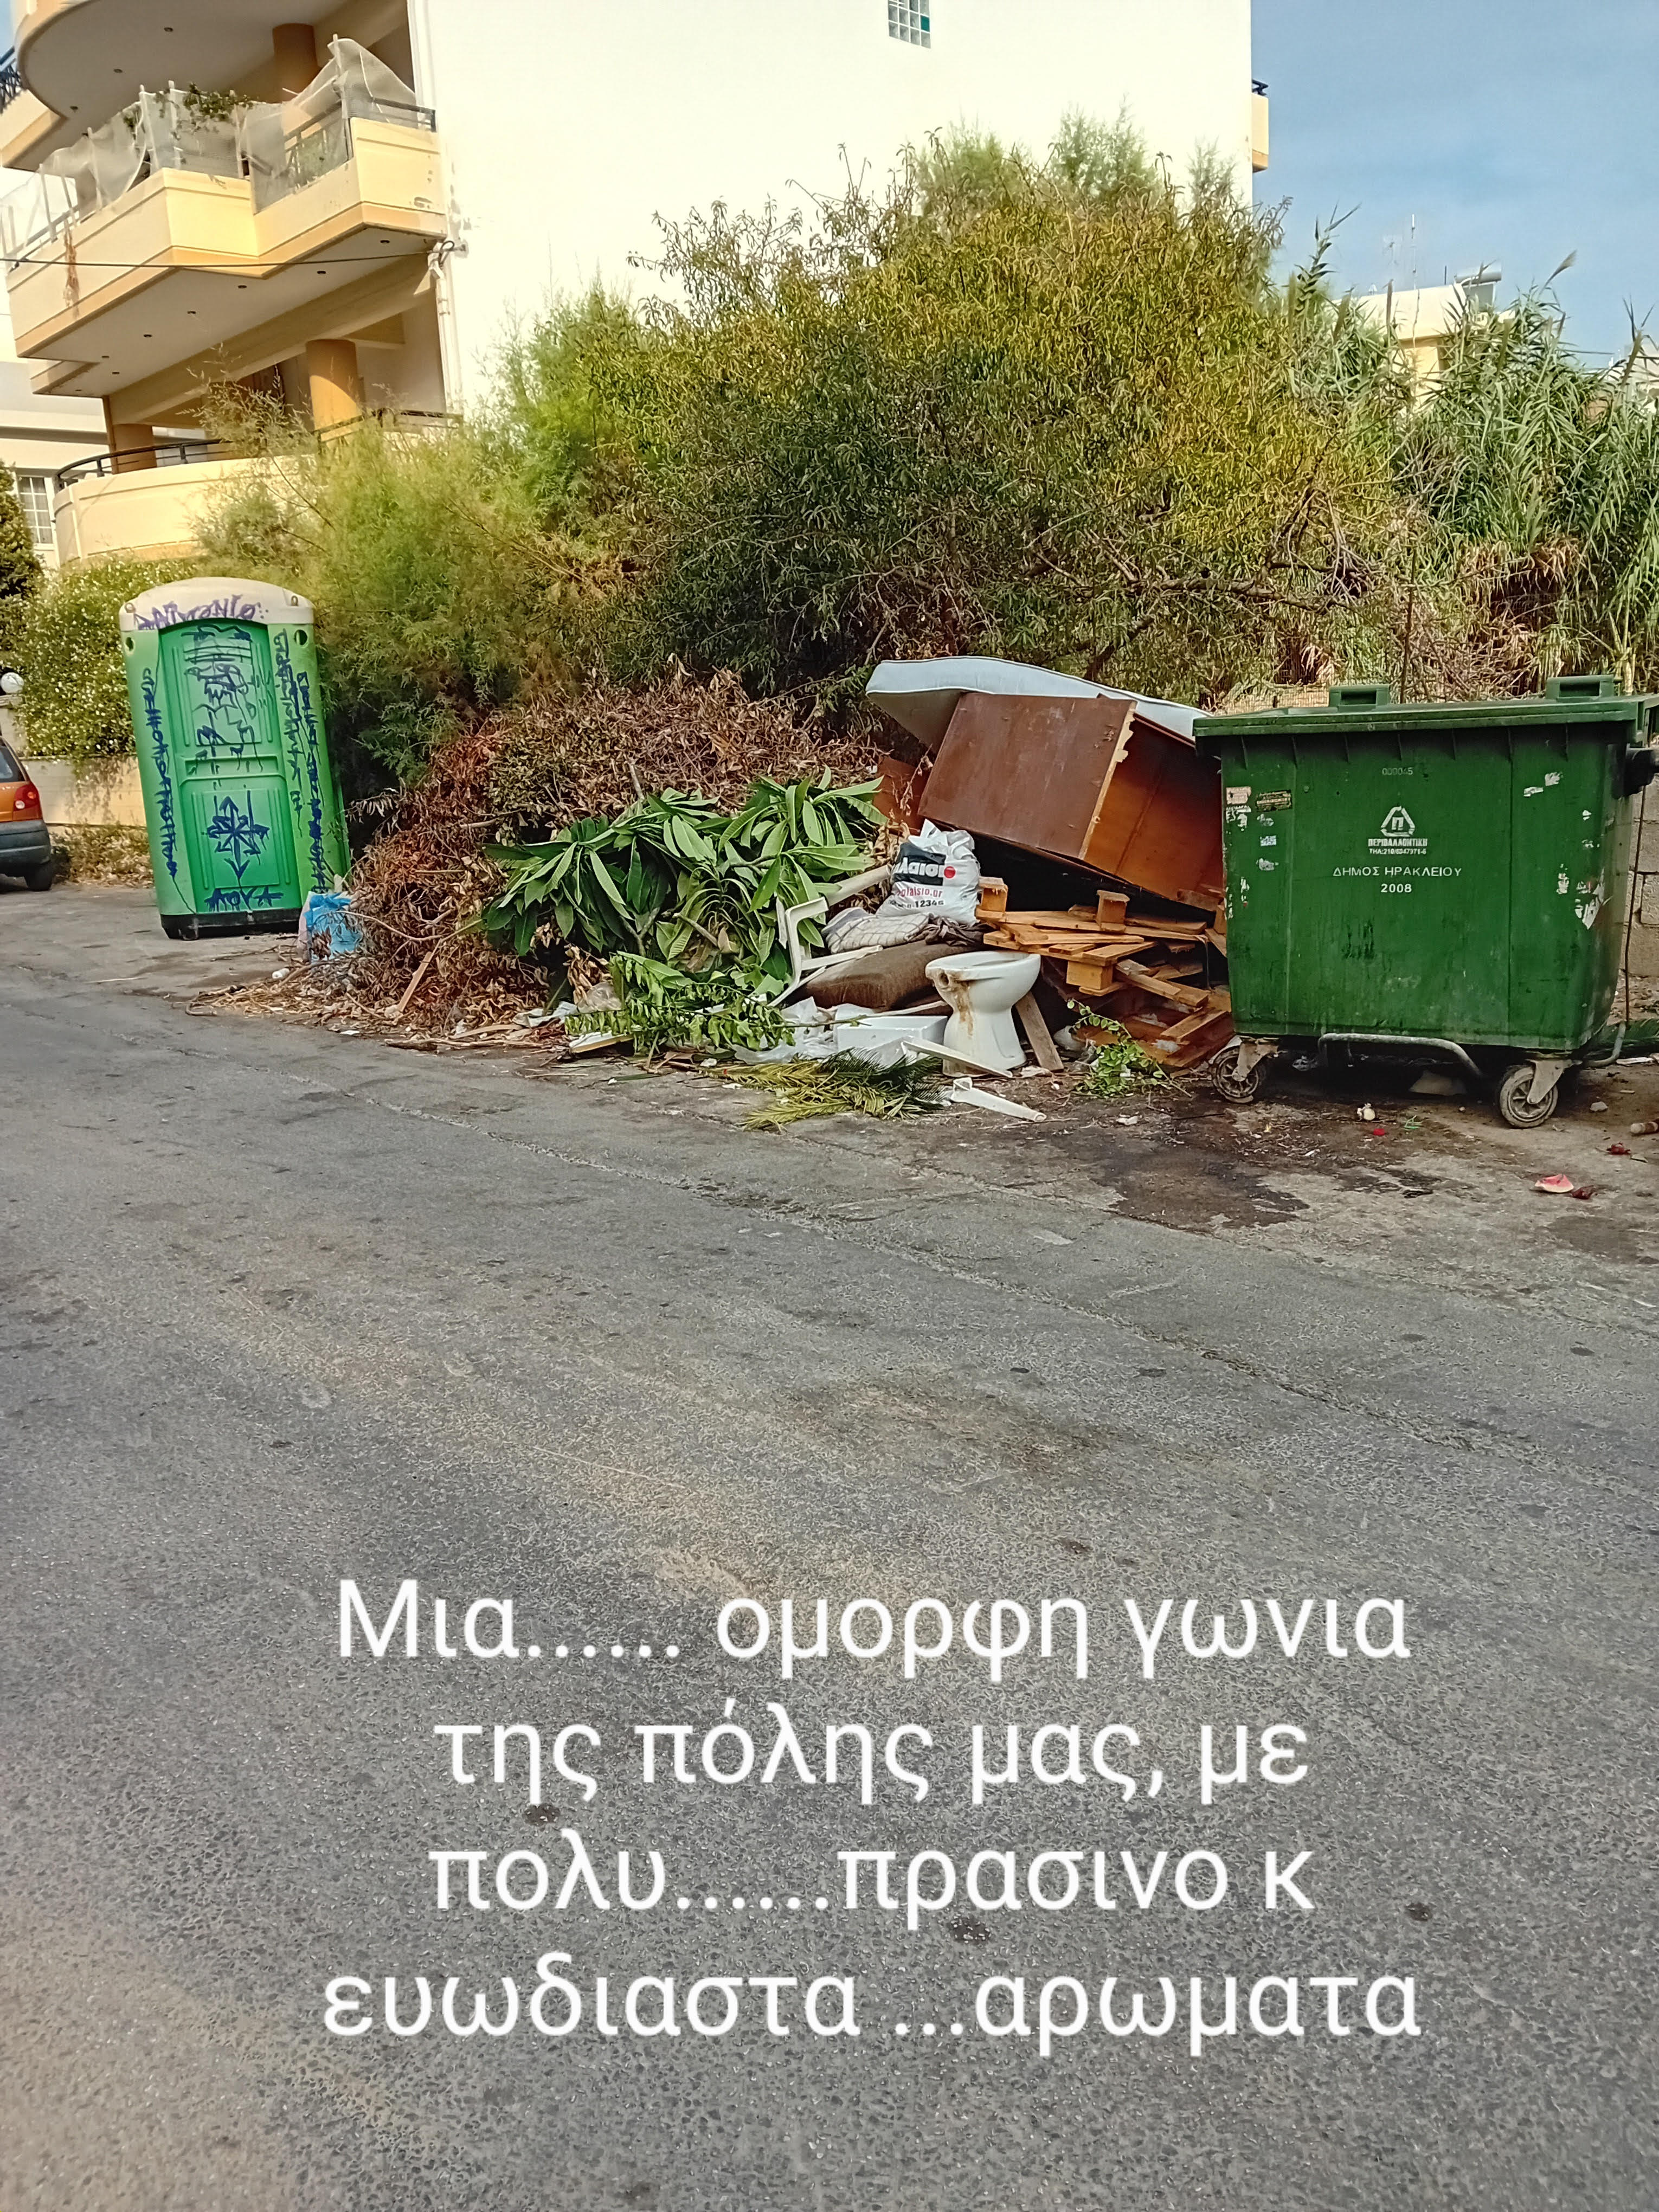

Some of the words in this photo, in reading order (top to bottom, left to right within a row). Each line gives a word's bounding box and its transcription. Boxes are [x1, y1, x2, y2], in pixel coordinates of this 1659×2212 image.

[1368, 838, 1428, 847] ΠΕΡΙΒΑΛΛΟΝΤΙΚΗ
[1333, 866, 1380, 877] ΔΗΜΟΣ
[1385, 866, 1462, 877] ΗΡΑΚΛΕΙΟΥ
[1380, 883, 1412, 893] 2008
